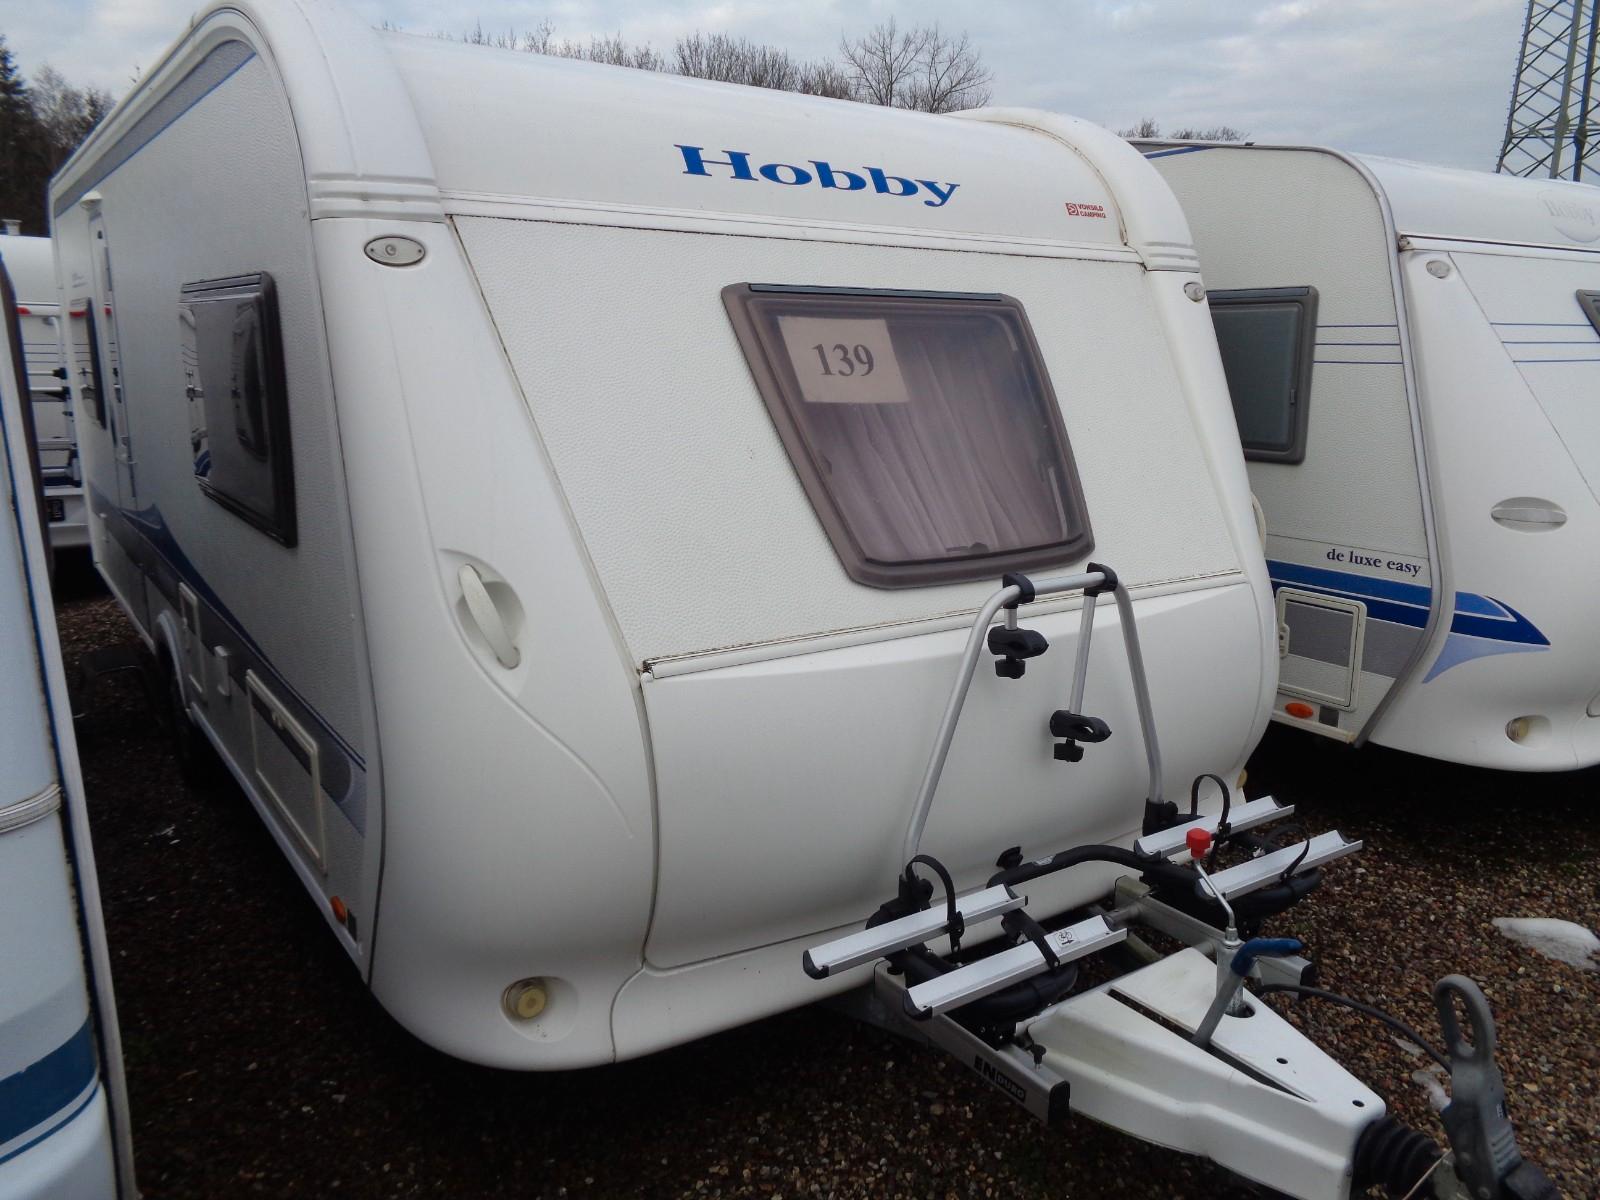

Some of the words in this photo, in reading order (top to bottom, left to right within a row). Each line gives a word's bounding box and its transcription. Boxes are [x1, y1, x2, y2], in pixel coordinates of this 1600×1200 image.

[674, 144, 960, 207] Hobby
[812, 342, 874, 378] 139
[1326, 548, 1344, 562] de
[1349, 550, 1382, 568] luxe
[1386, 559, 1421, 577] easy
[974, 1054, 1026, 1102] ENDURO
